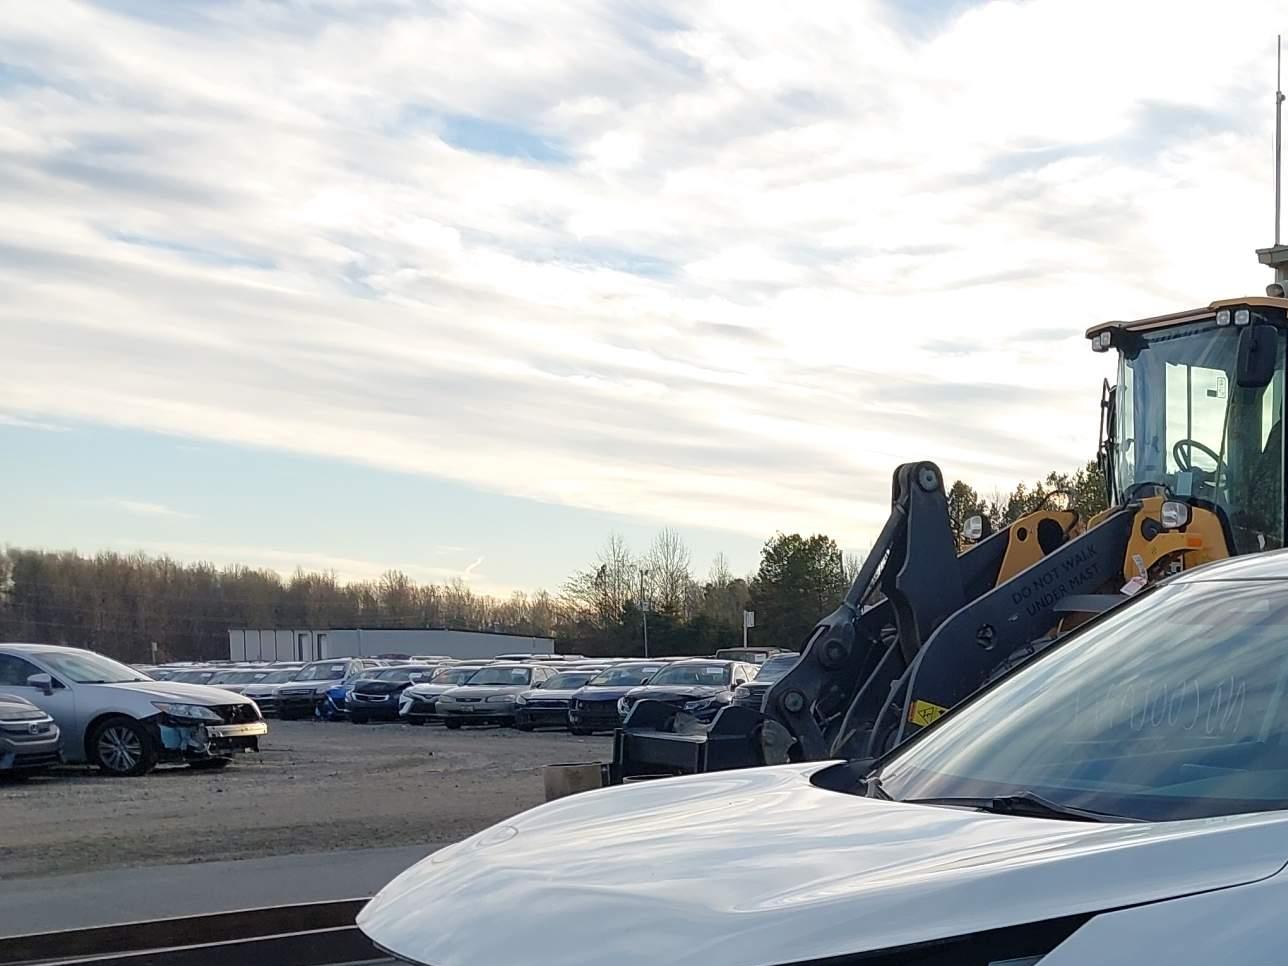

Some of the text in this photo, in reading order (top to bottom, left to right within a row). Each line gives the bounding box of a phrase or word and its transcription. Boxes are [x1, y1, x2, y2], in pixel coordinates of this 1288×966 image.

[1012, 544, 1097, 604] DO NOT WALK
[1027, 563, 1099, 616] UNDER MAST
